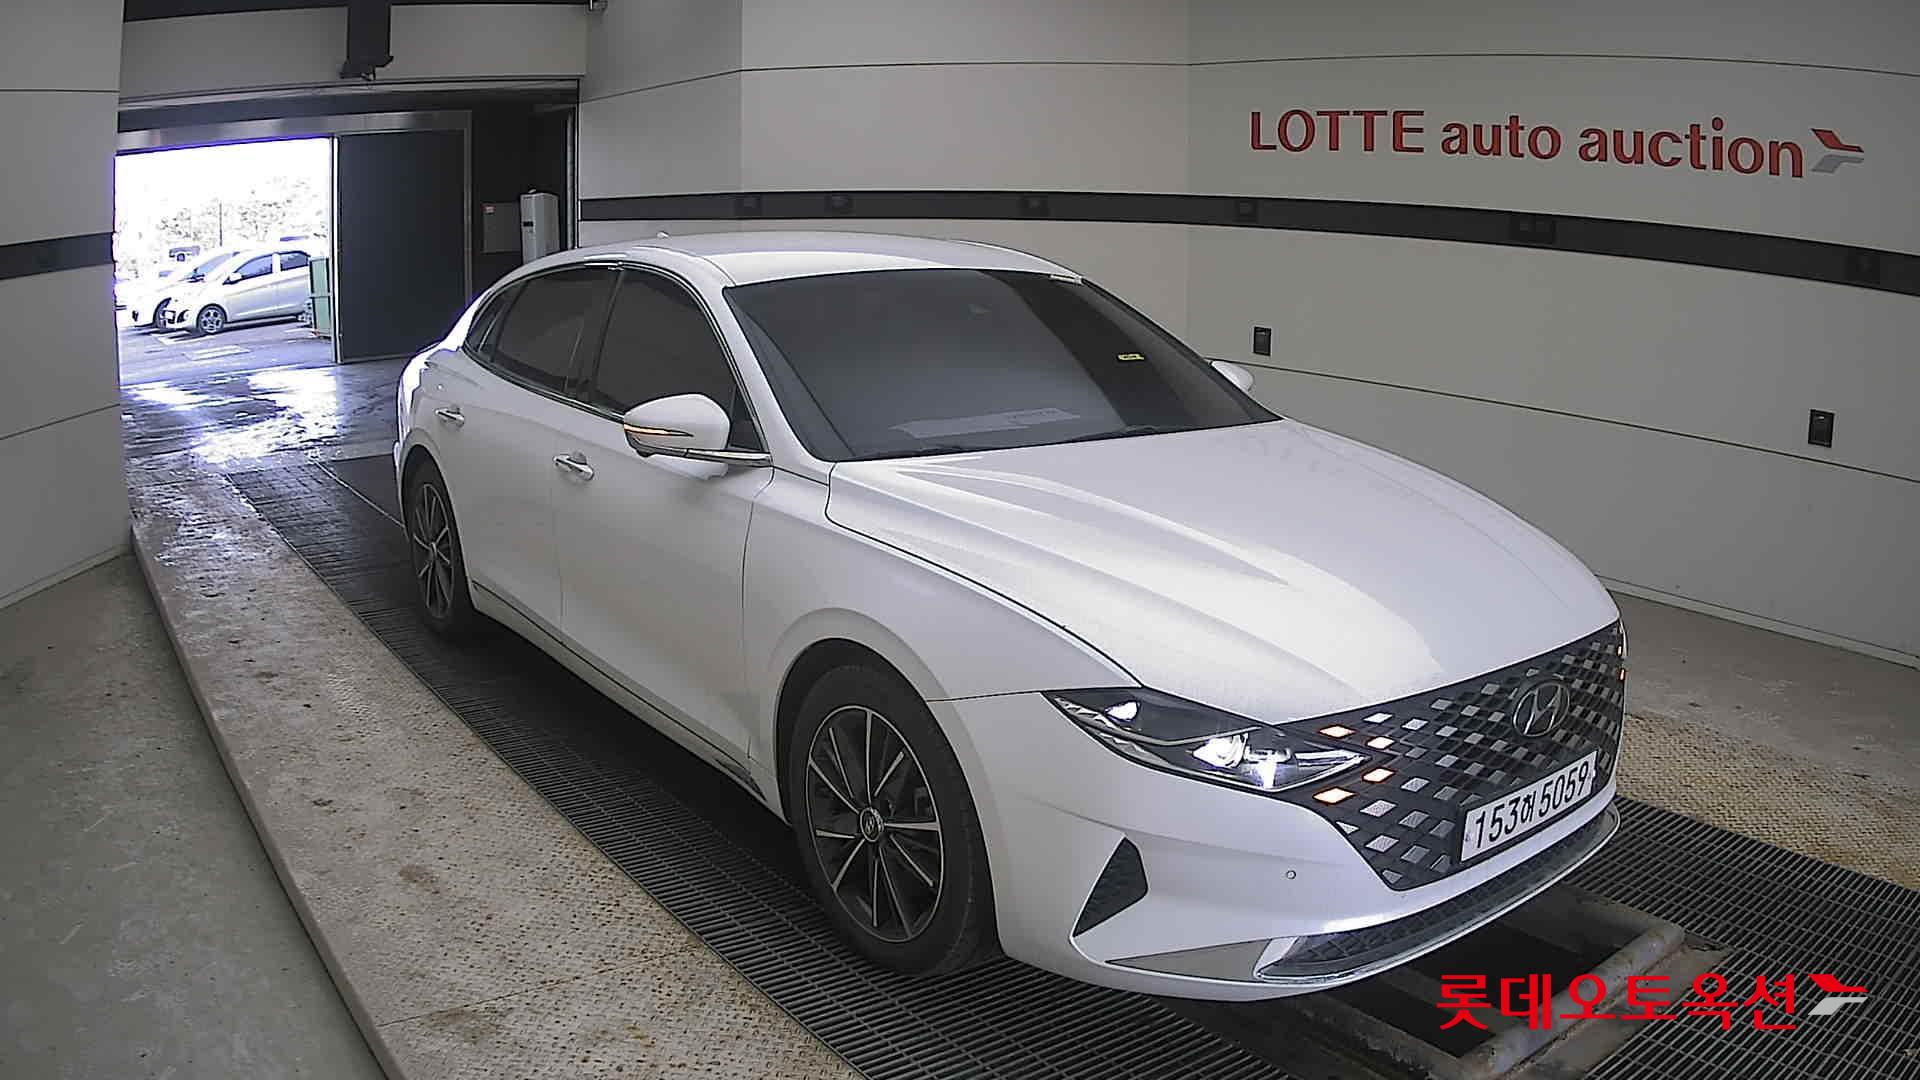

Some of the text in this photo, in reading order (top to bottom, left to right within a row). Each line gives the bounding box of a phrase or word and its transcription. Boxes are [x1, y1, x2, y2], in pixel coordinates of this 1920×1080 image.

[1250, 110, 1804, 178] LOTTE auto auction
